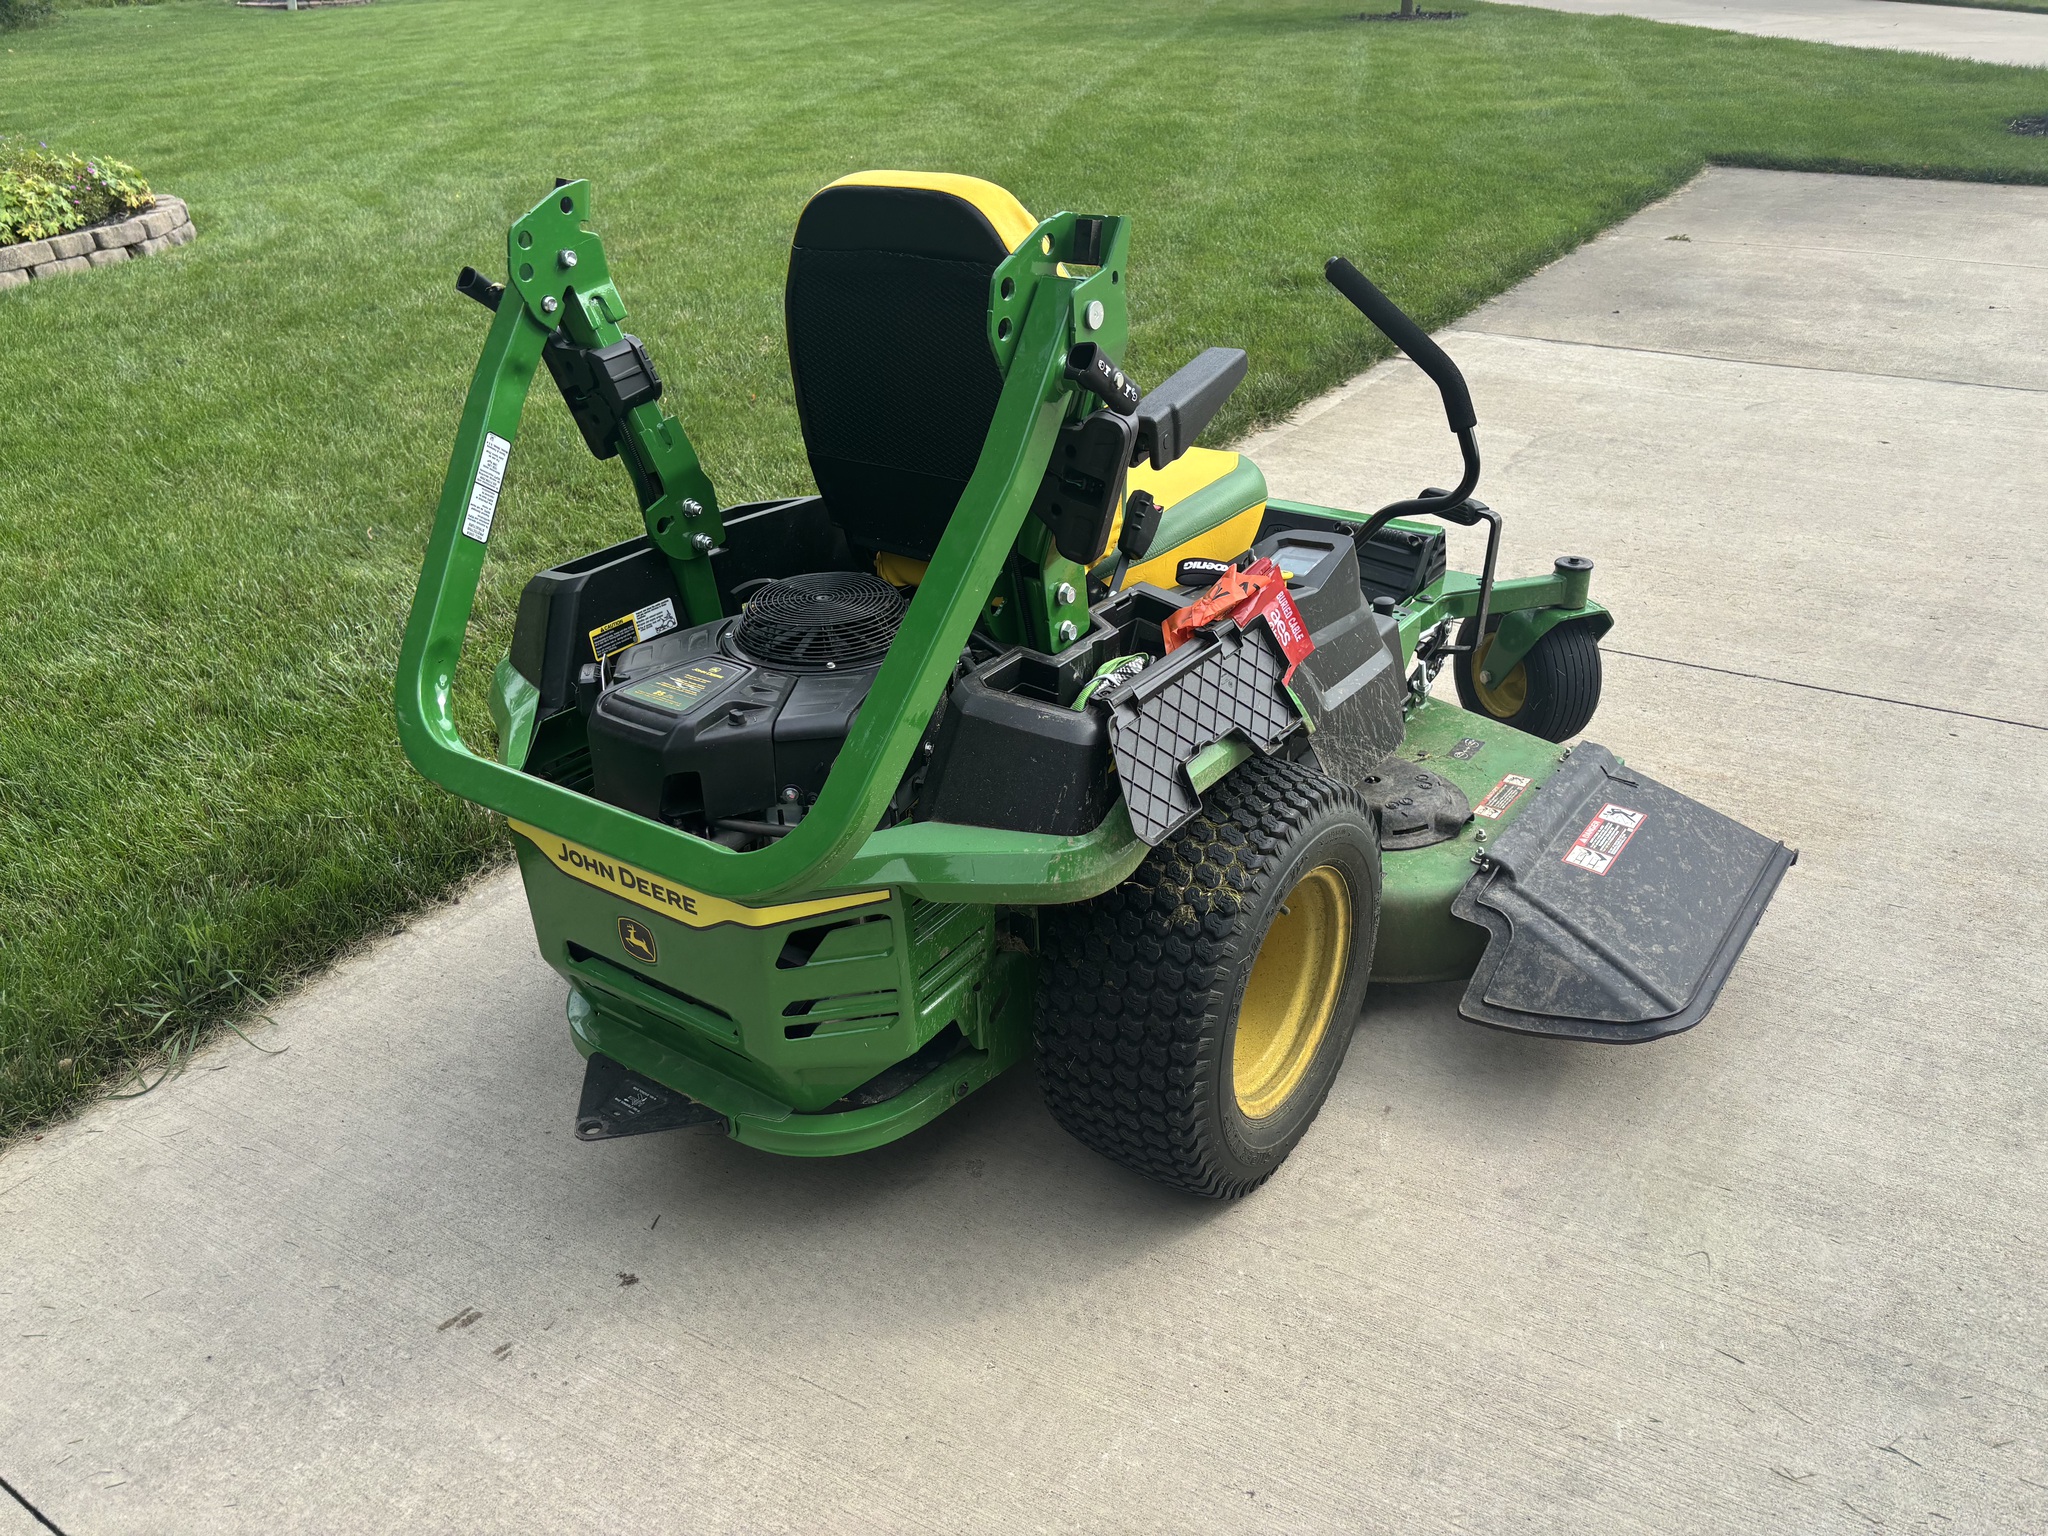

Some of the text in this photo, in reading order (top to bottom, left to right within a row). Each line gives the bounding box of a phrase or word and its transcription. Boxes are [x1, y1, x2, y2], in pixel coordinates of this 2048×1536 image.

[603, 619, 624, 632] CAUTION
[1270, 608, 1290, 647] aes
[1276, 590, 1304, 643] BURIED CABLE
[1581, 820, 1601, 839] DANGER
[558, 843, 699, 916] JOHN DEERE
